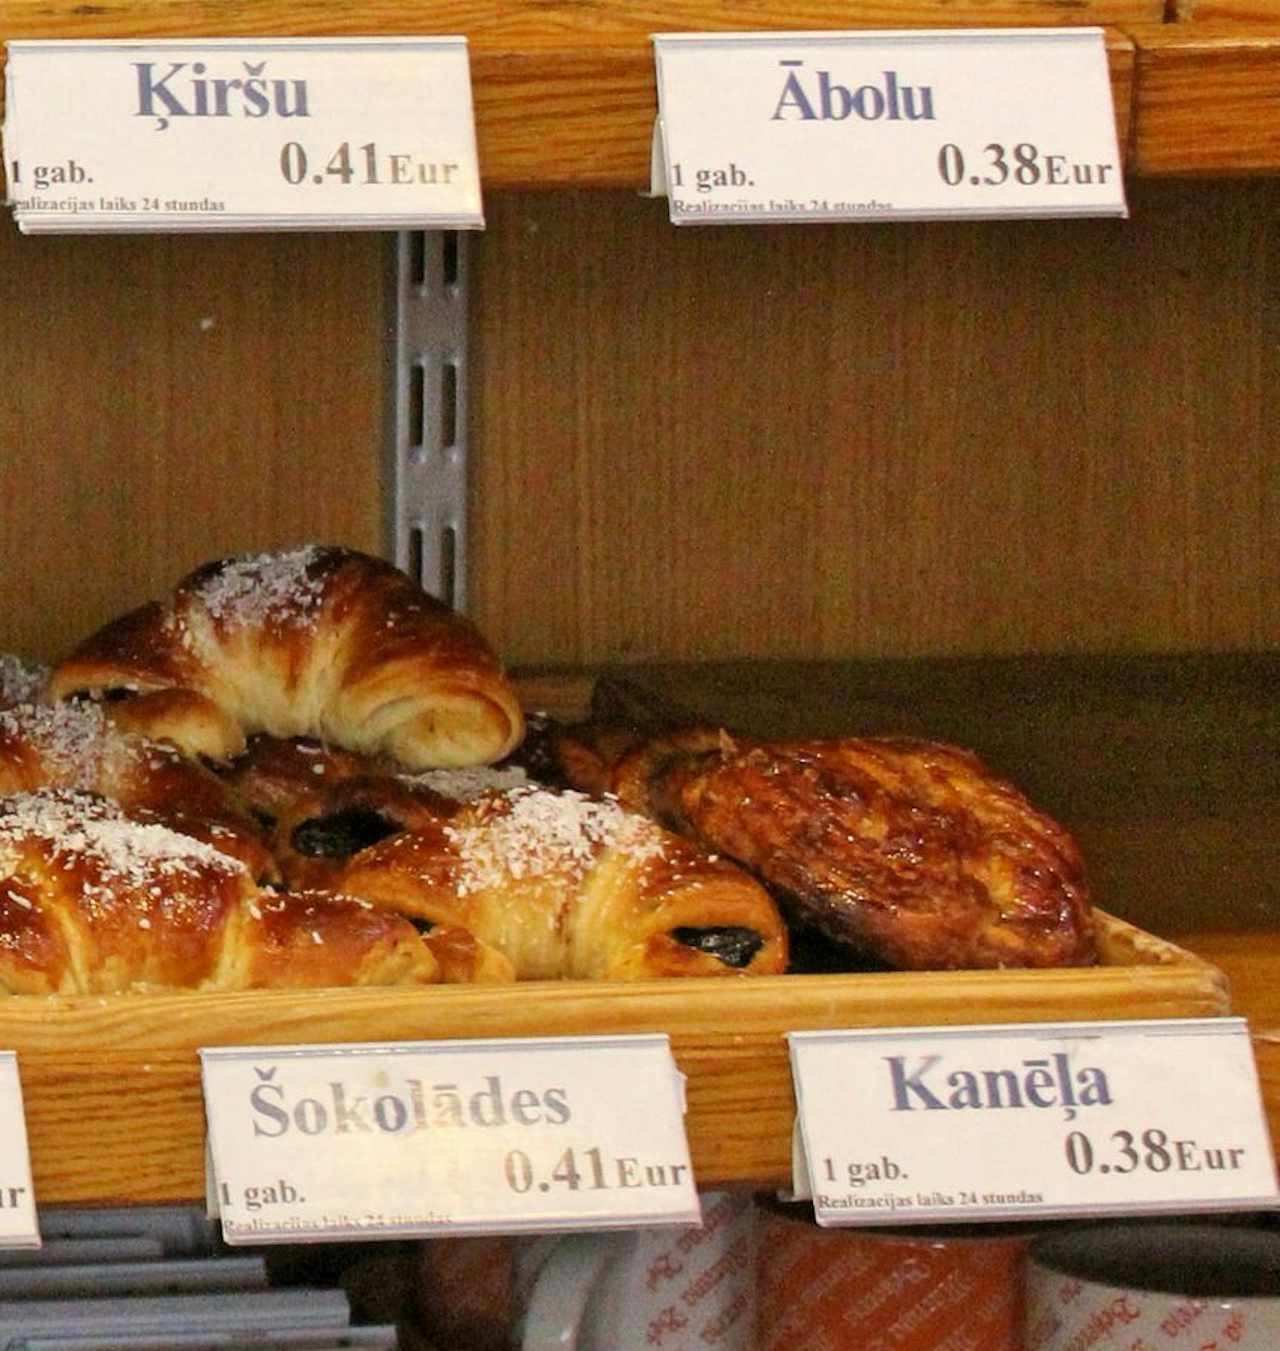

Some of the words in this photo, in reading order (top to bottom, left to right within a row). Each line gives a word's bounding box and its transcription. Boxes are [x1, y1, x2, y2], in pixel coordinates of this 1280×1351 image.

[131, 60, 310, 131] Ķiršu
[771, 59, 935, 122] Ābolu
[10, 161, 22, 184] 1
[33, 161, 94, 188] gab.
[672, 163, 683, 186] 1
[696, 163, 755, 192] gab.
[11, 197, 95, 214] ealizacijas
[99, 197, 137, 212] laiks
[141, 197, 161, 212] 24
[165, 197, 226, 212] stundas
[250, 1065, 572, 1138] Šokolādes
[883, 1053, 1113, 1122] Kanēļa
[823, 1158, 836, 1182] 1
[847, 1157, 909, 1187] gab.
[220, 1182, 231, 1205] 1
[244, 1180, 306, 1211] gab.
[818, 1194, 913, 1210] Realizacijas
[916, 1192, 955, 1207] laiks
[958, 1192, 978, 1205] 24
[982, 1190, 1043, 1205] stundas
